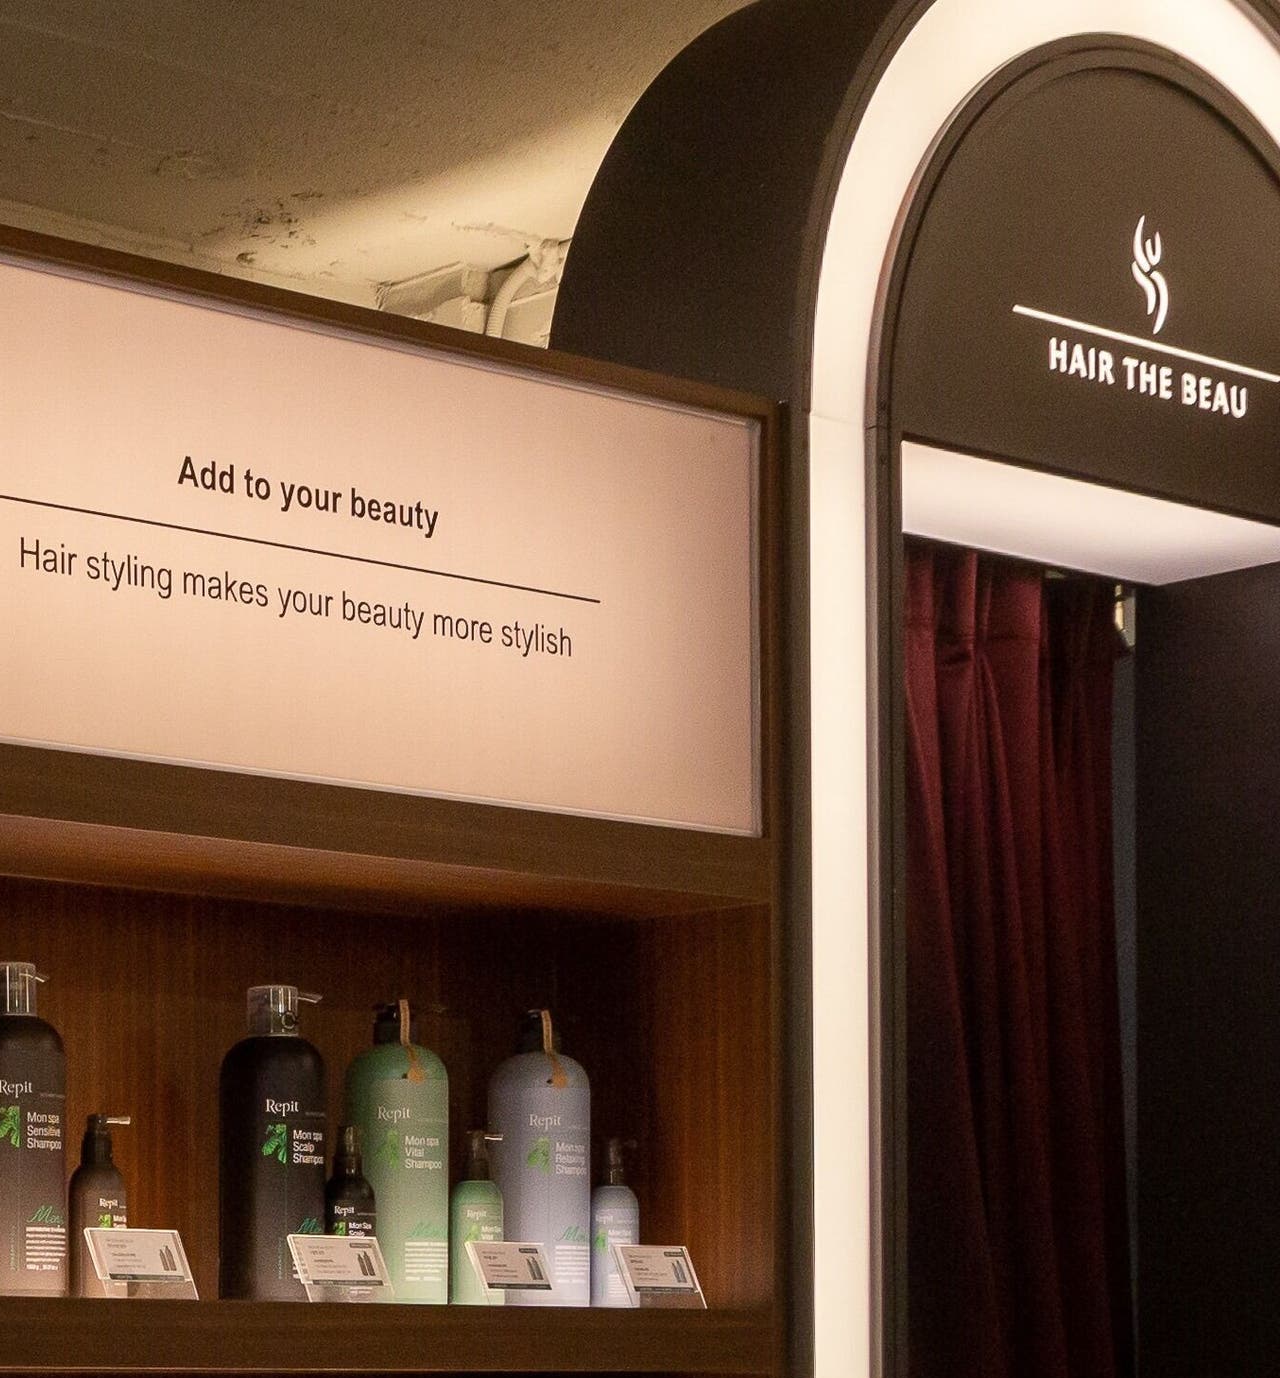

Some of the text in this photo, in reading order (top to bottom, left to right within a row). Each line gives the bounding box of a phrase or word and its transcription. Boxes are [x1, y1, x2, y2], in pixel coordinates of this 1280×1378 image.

[1048, 337, 1249, 418] HAIR THE BEAU
[177, 455, 439, 538] Add to your beauty
[20, 536, 573, 658] Hair styling makes your beauty more stylish
[265, 1098, 300, 1117] Repit
[376, 1105, 411, 1123] Repit
[26, 1111, 60, 1125] Mon spa
[529, 1113, 561, 1131] Repit
[292, 1130, 312, 1141] Mon
[404, 1135, 425, 1146] Mon
[26, 1137, 62, 1151] Shampoo
[292, 1140, 315, 1154] Scalp
[404, 1147, 425, 1158] Vital
[404, 1158, 442, 1170] Shampoo
